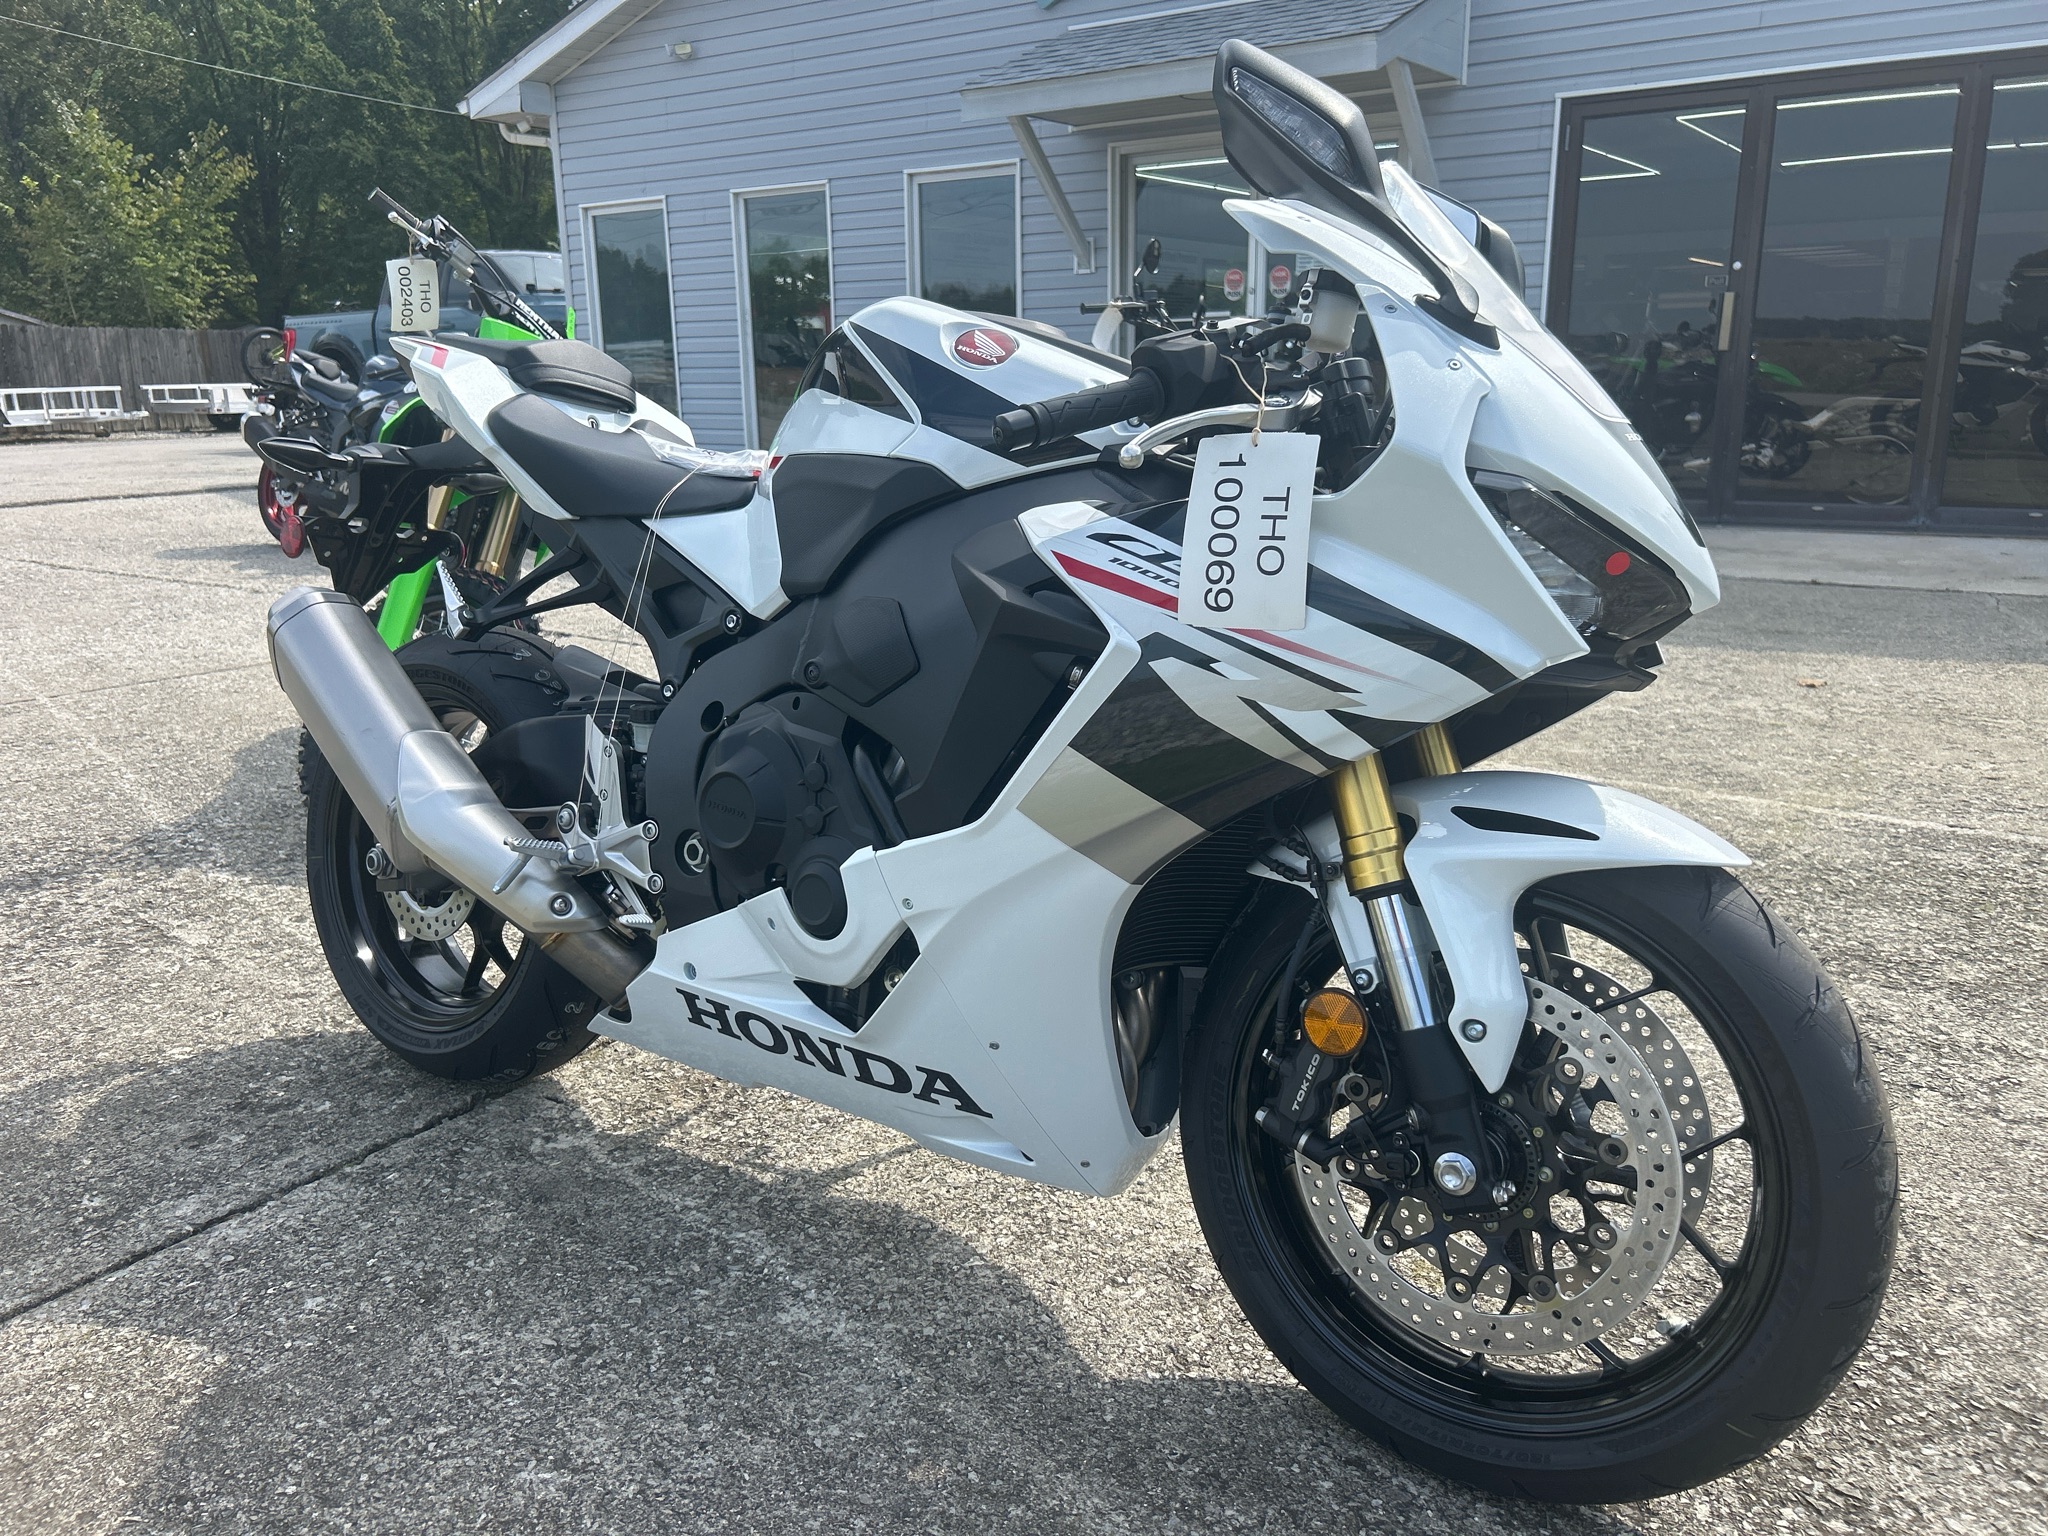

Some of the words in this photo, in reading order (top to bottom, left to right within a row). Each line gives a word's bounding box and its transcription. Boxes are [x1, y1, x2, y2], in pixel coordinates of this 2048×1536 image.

[397, 266, 414, 327] 002403
[419, 280, 432, 313] THO
[957, 345, 998, 364] HONDA
[1203, 453, 1247, 613] 100069
[1256, 486, 1291, 576] THO
[675, 987, 994, 1120] HONDA
[1291, 1053, 1320, 1111] TOKICO
